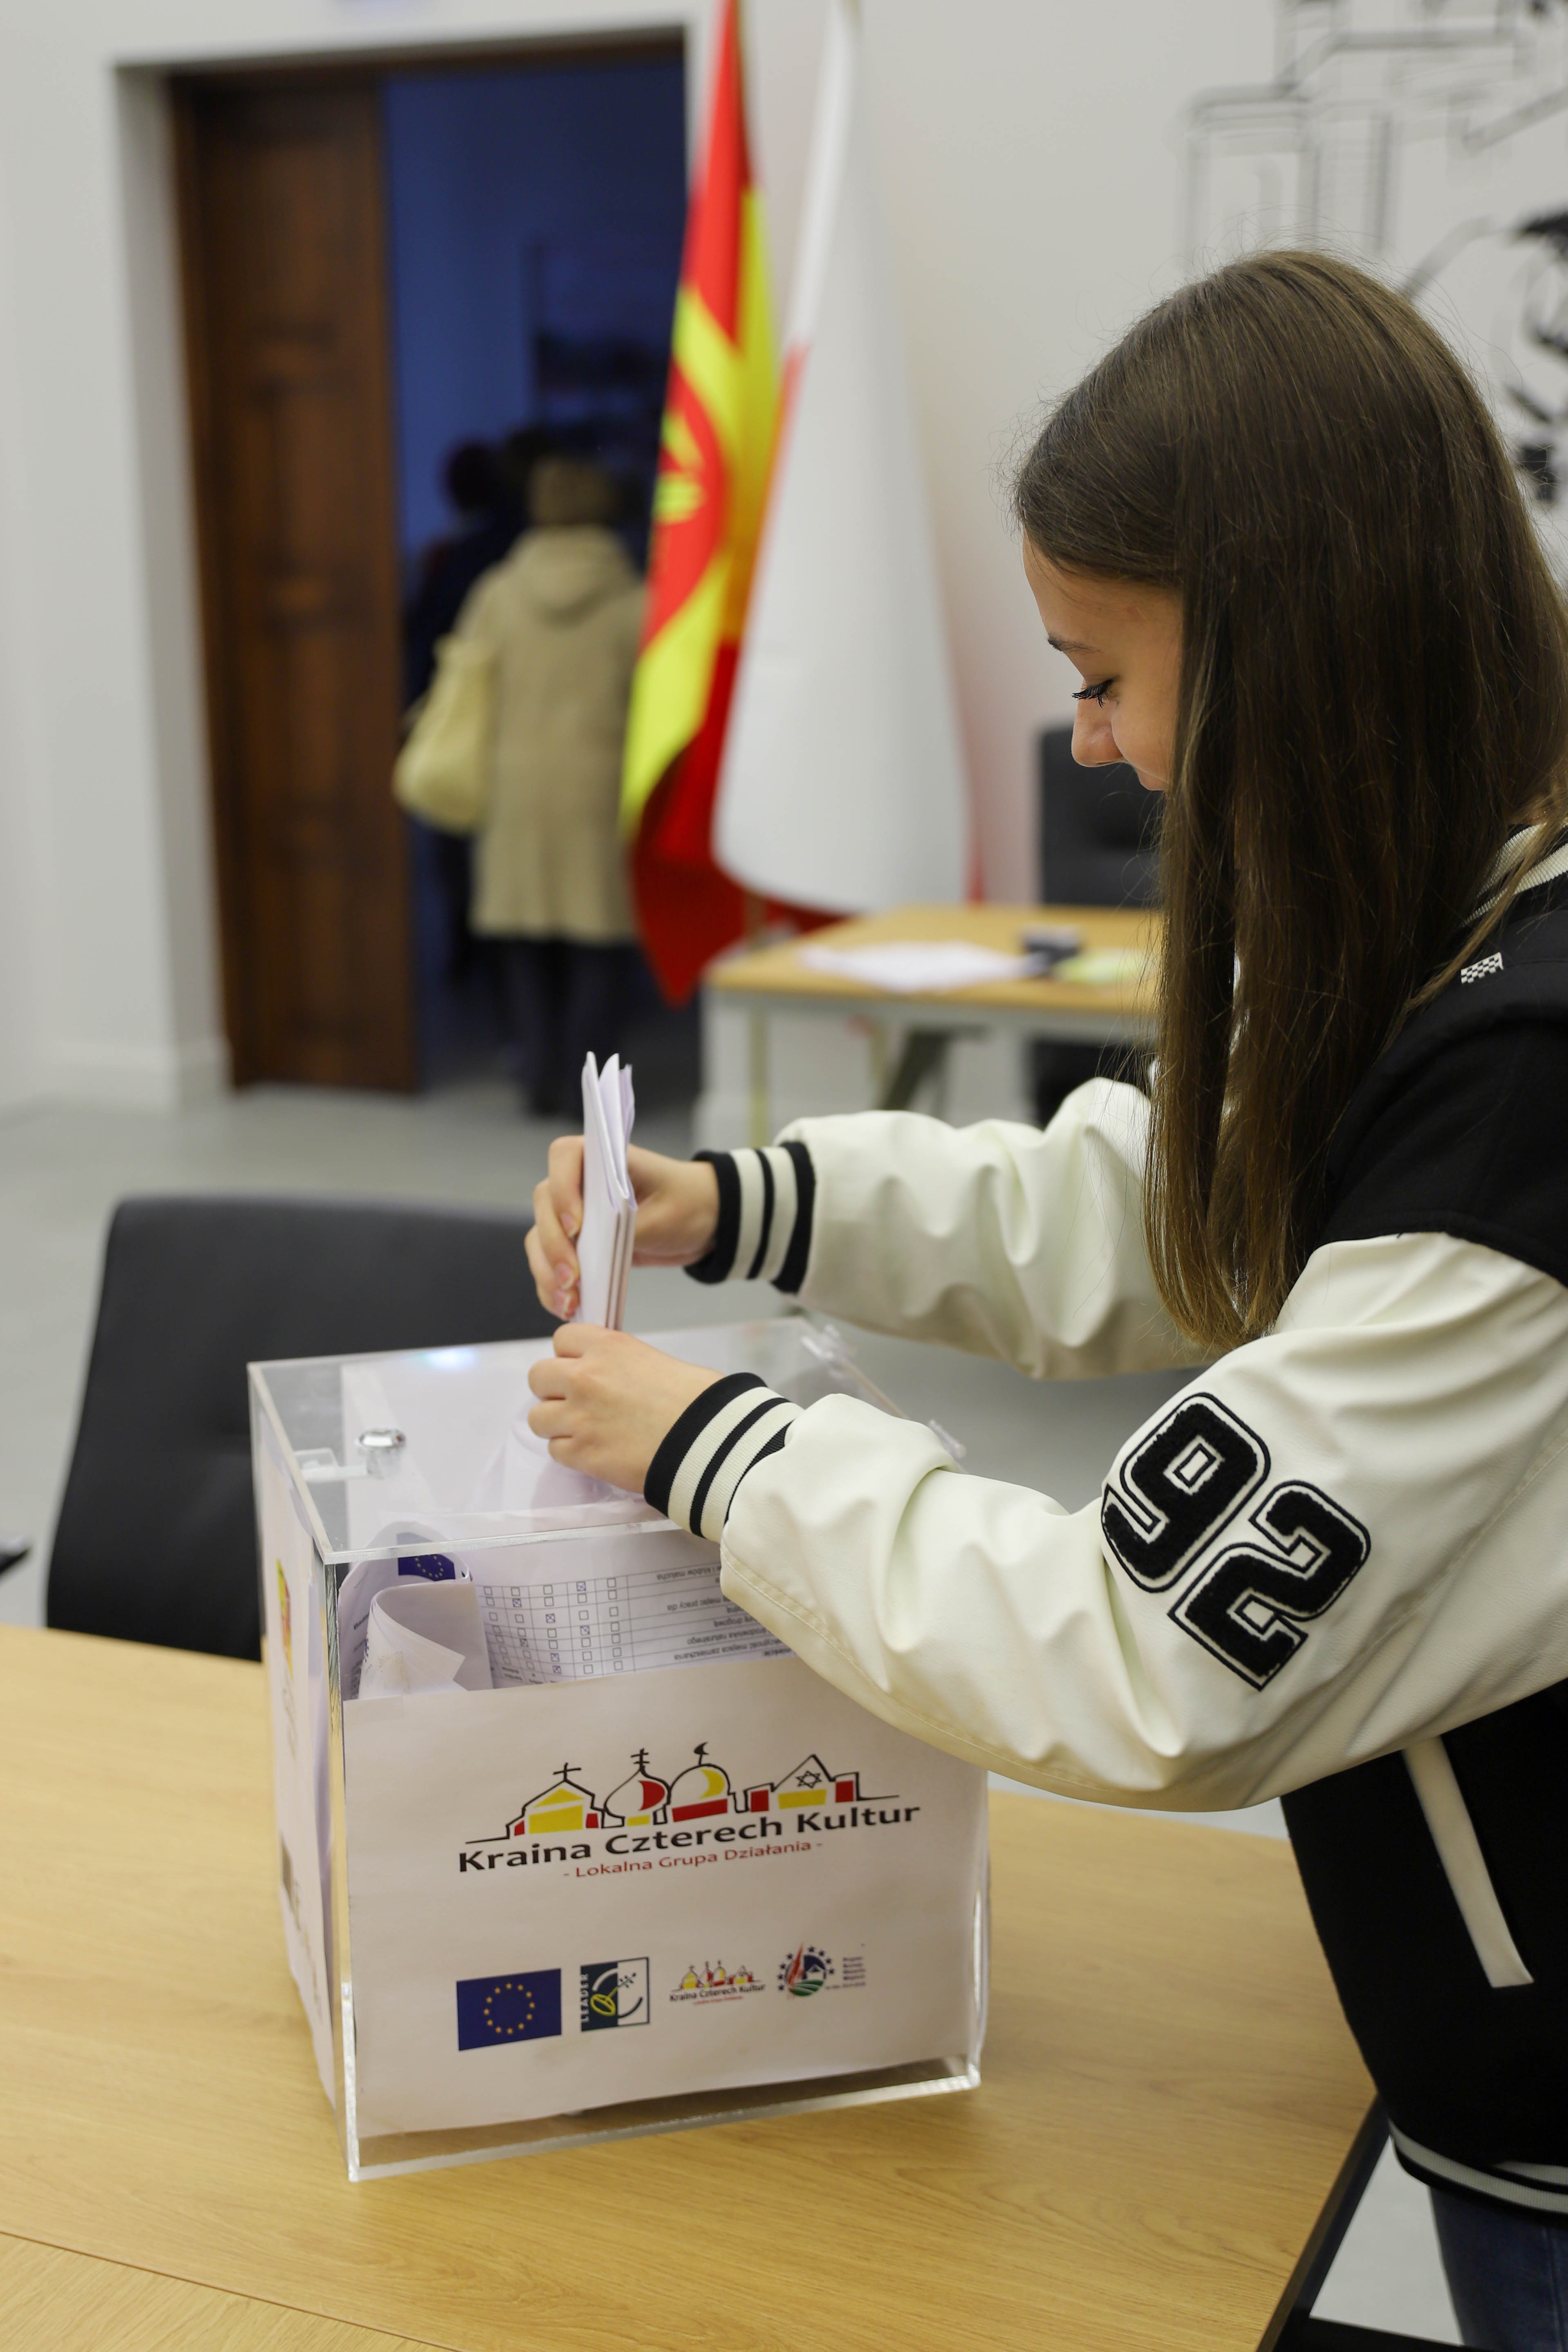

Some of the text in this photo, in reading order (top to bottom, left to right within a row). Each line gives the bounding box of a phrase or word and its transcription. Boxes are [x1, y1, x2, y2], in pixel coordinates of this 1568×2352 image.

[1101, 1392, 1371, 1692] 92
[459, 1806, 920, 1872] Kraina Czterech Kultur
[576, 1840, 811, 1877] Lokalna Grupa Działania
[581, 1973, 589, 2023] LEADER
